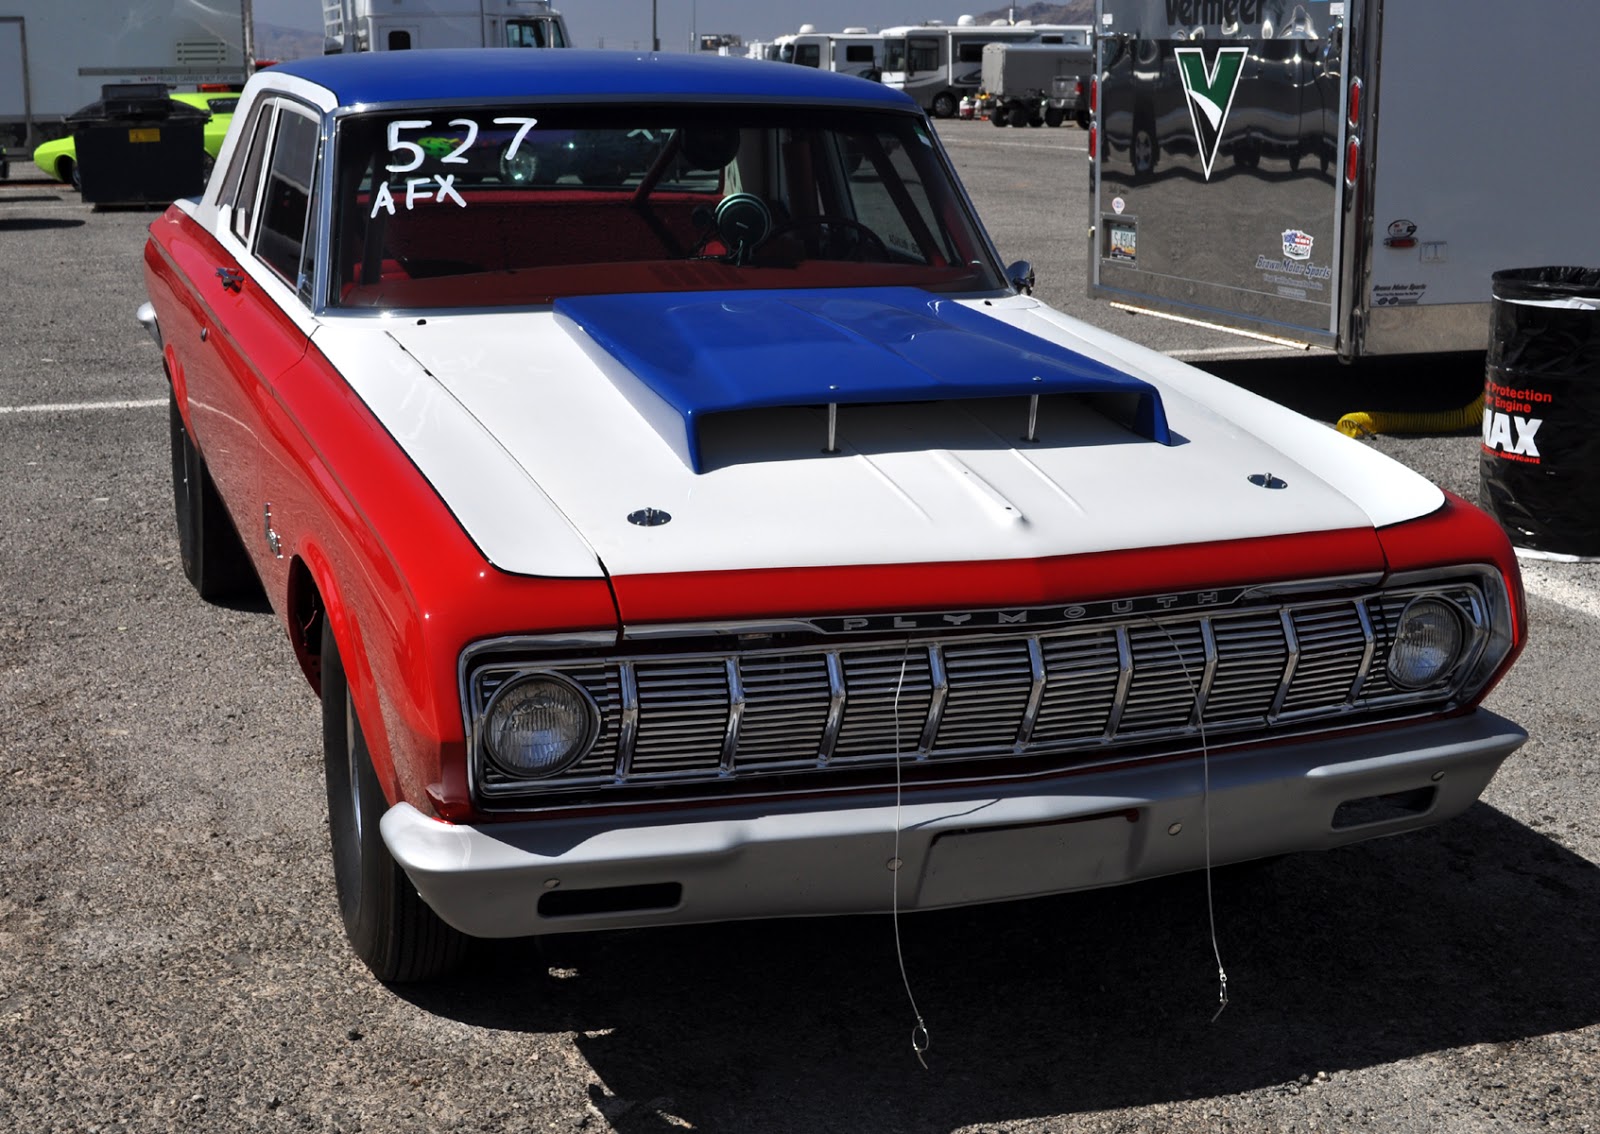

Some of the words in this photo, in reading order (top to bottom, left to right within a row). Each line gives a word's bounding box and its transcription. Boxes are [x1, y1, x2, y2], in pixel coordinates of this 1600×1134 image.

[385, 117, 538, 173] 527
[371, 174, 467, 219] AFX
[1256, 255, 1280, 271] Brown
[1281, 259, 1304, 274] Motor
[1305, 262, 1331, 279] Sports
[1491, 382, 1552, 403] Protection
[1495, 396, 1531, 413] Engine
[843, 591, 1218, 631] PLYMOUTH
